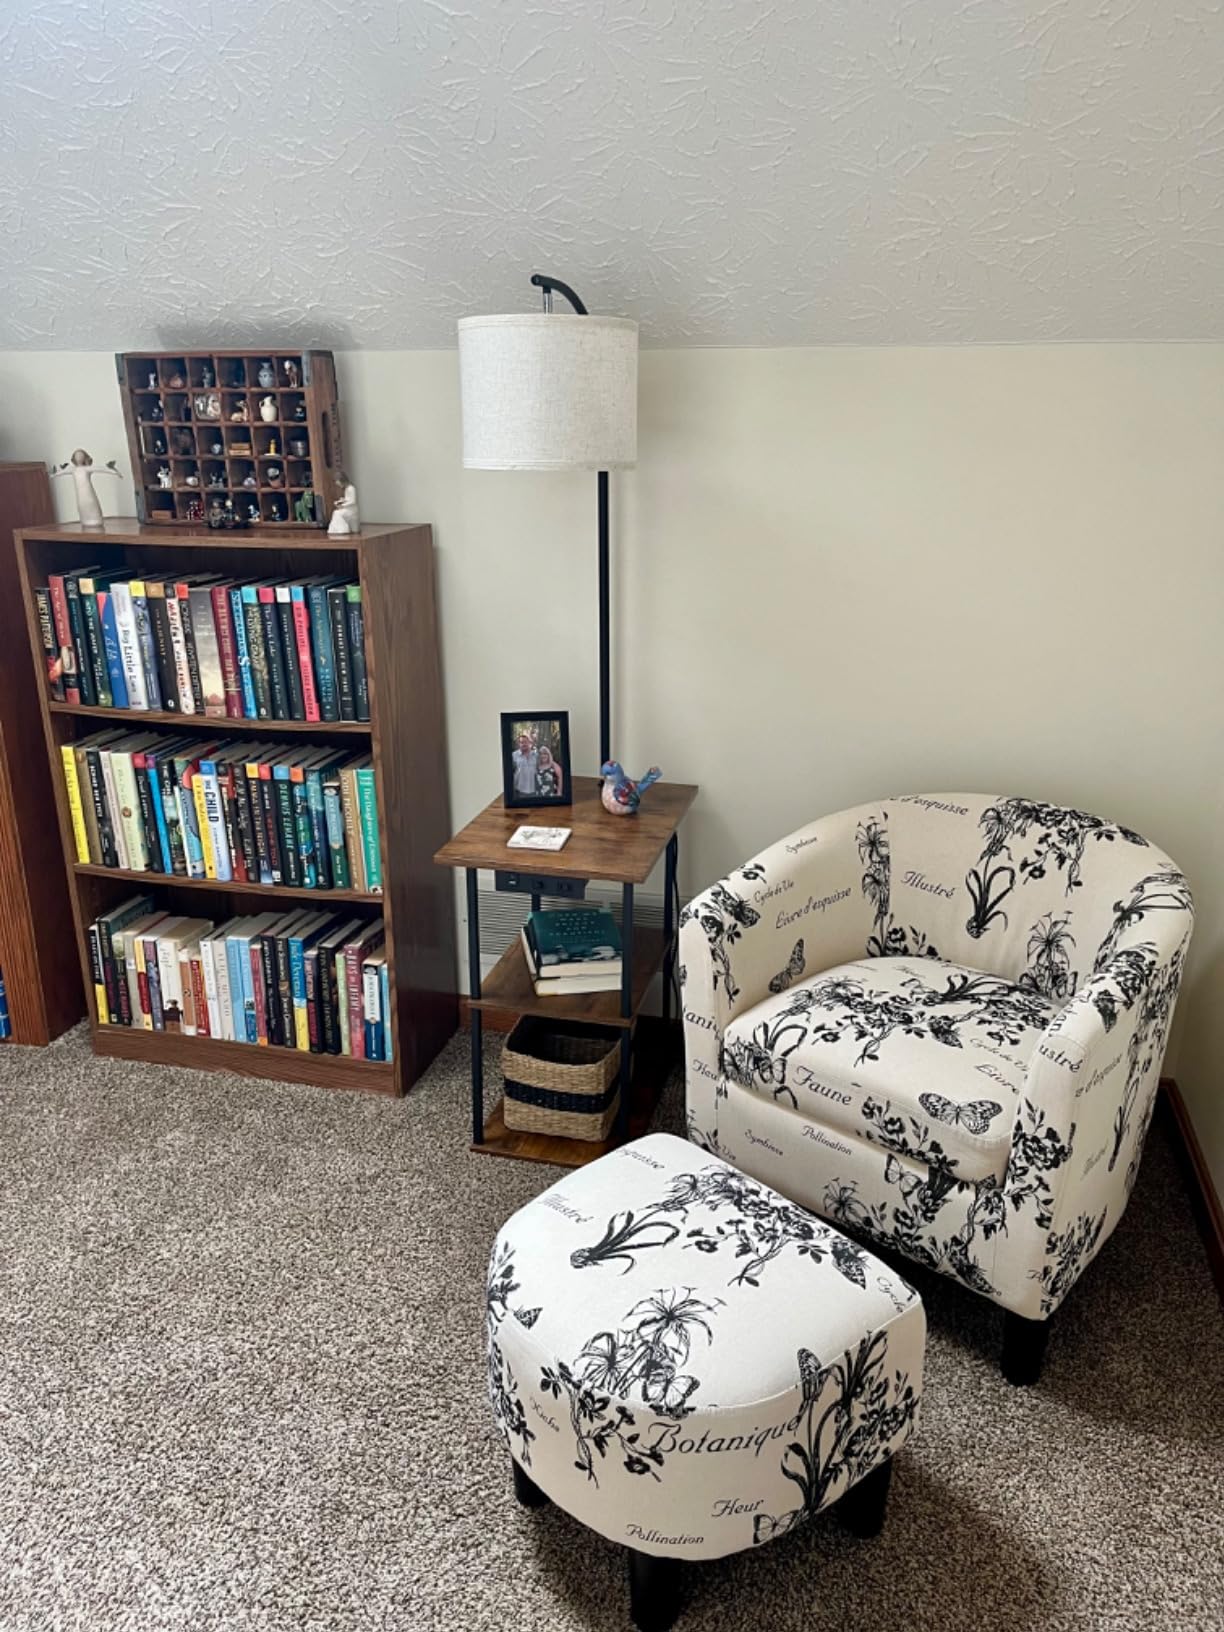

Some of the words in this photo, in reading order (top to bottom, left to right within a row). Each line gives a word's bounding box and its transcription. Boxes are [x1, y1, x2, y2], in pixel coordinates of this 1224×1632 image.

[204, 791, 219, 822] CHILD
[901, 871, 957, 900] Illustré
[1039, 1045, 1084, 1074] ustré
[793, 1066, 852, 1106] Faune
[802, 1125, 853, 1156] Pollination
[641, 1415, 802, 1458] Botanique
[626, 1523, 705, 1546] Pollination
